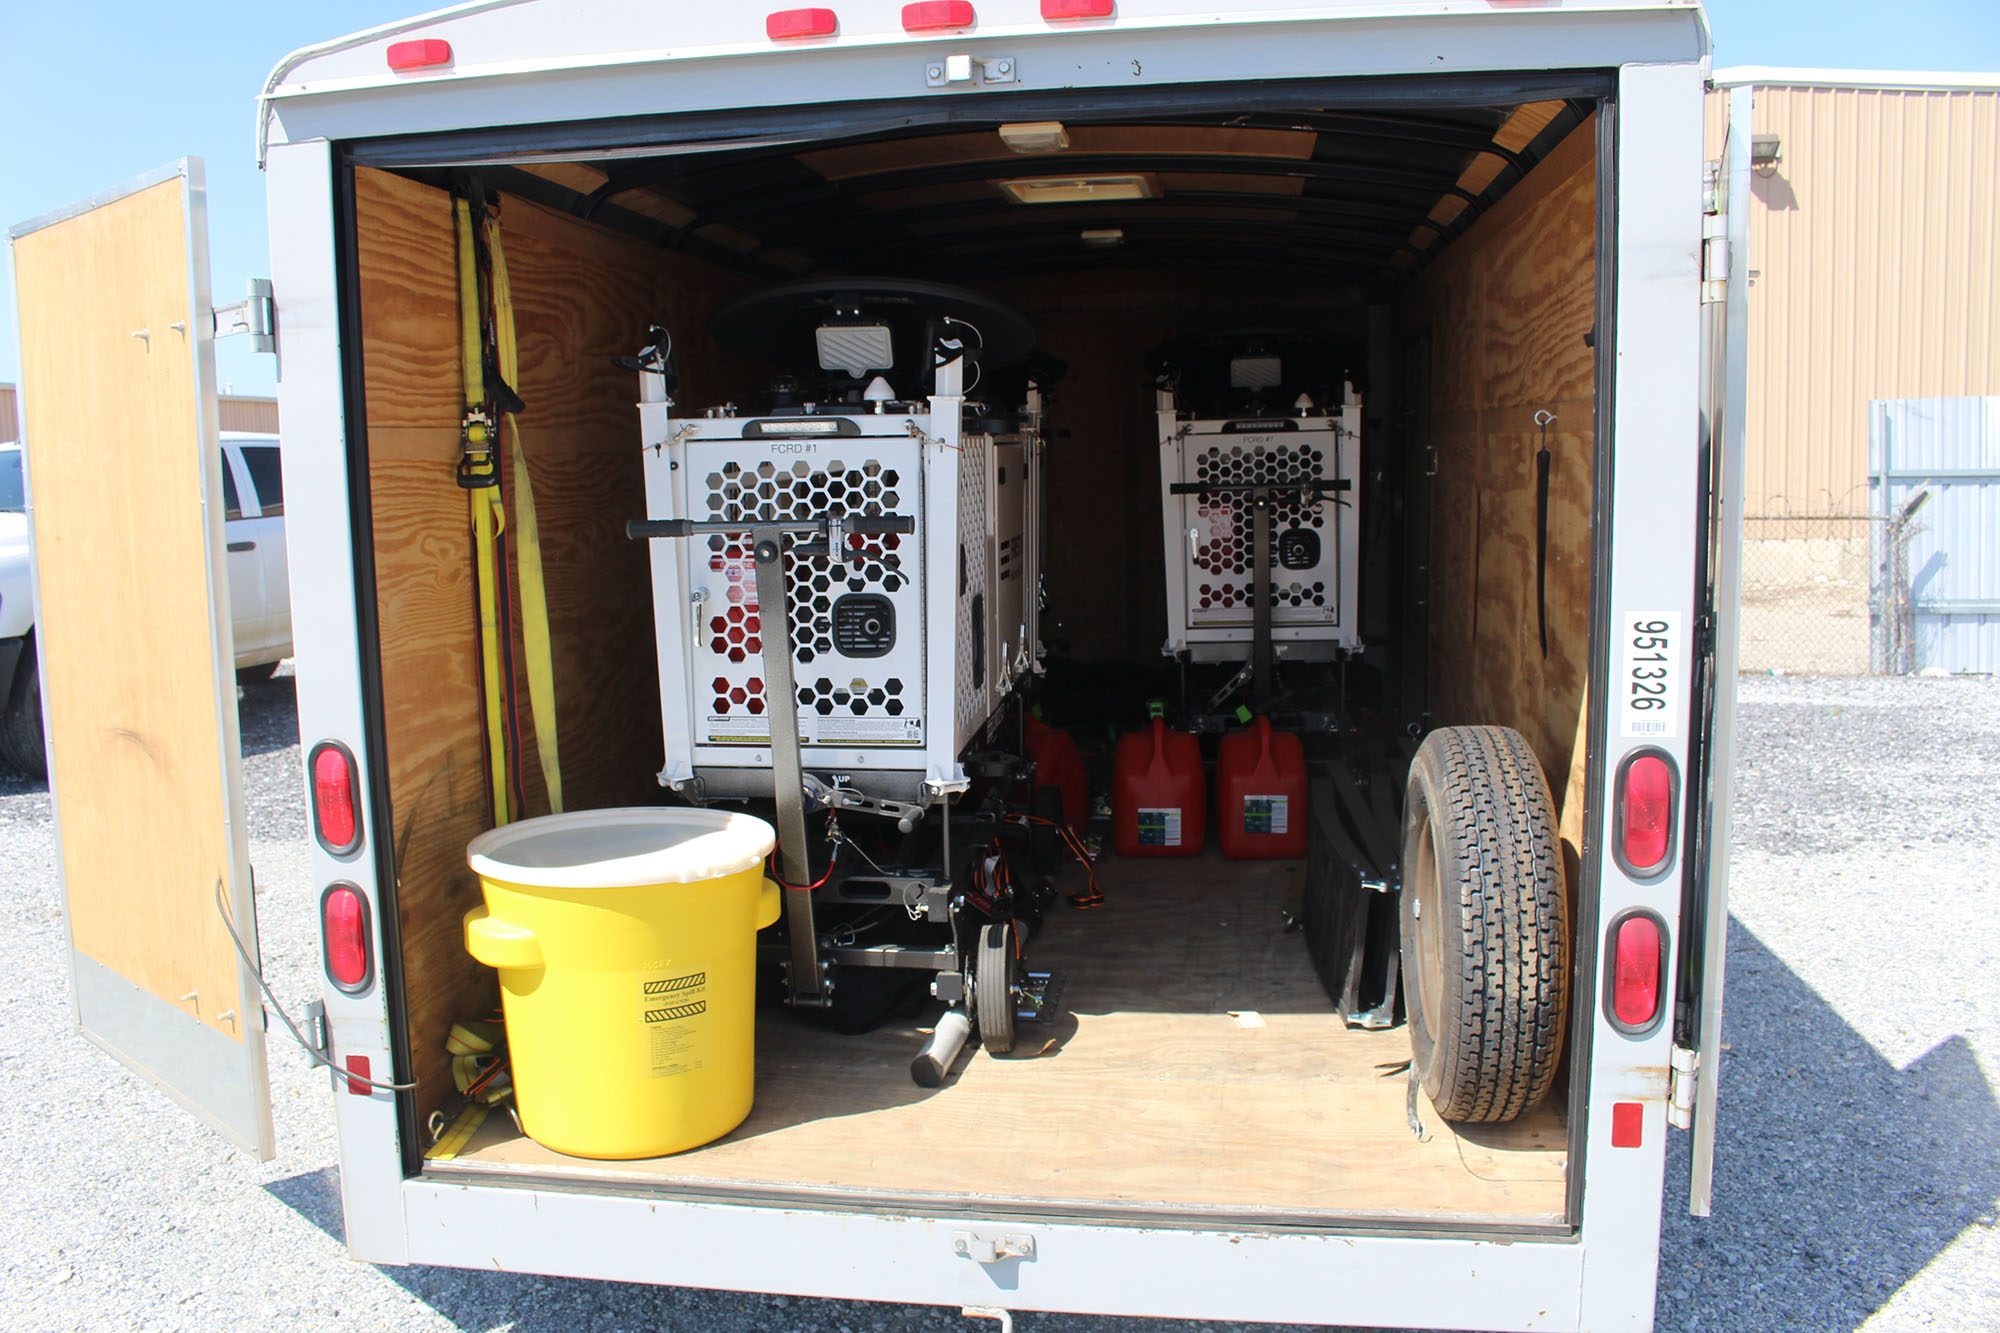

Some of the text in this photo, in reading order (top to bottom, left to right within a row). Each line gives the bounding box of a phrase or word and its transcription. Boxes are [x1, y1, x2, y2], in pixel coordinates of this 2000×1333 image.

[771, 443, 817, 454] FCRD #1
[1630, 620, 1670, 711] 951326
[838, 775, 851, 783] UP
